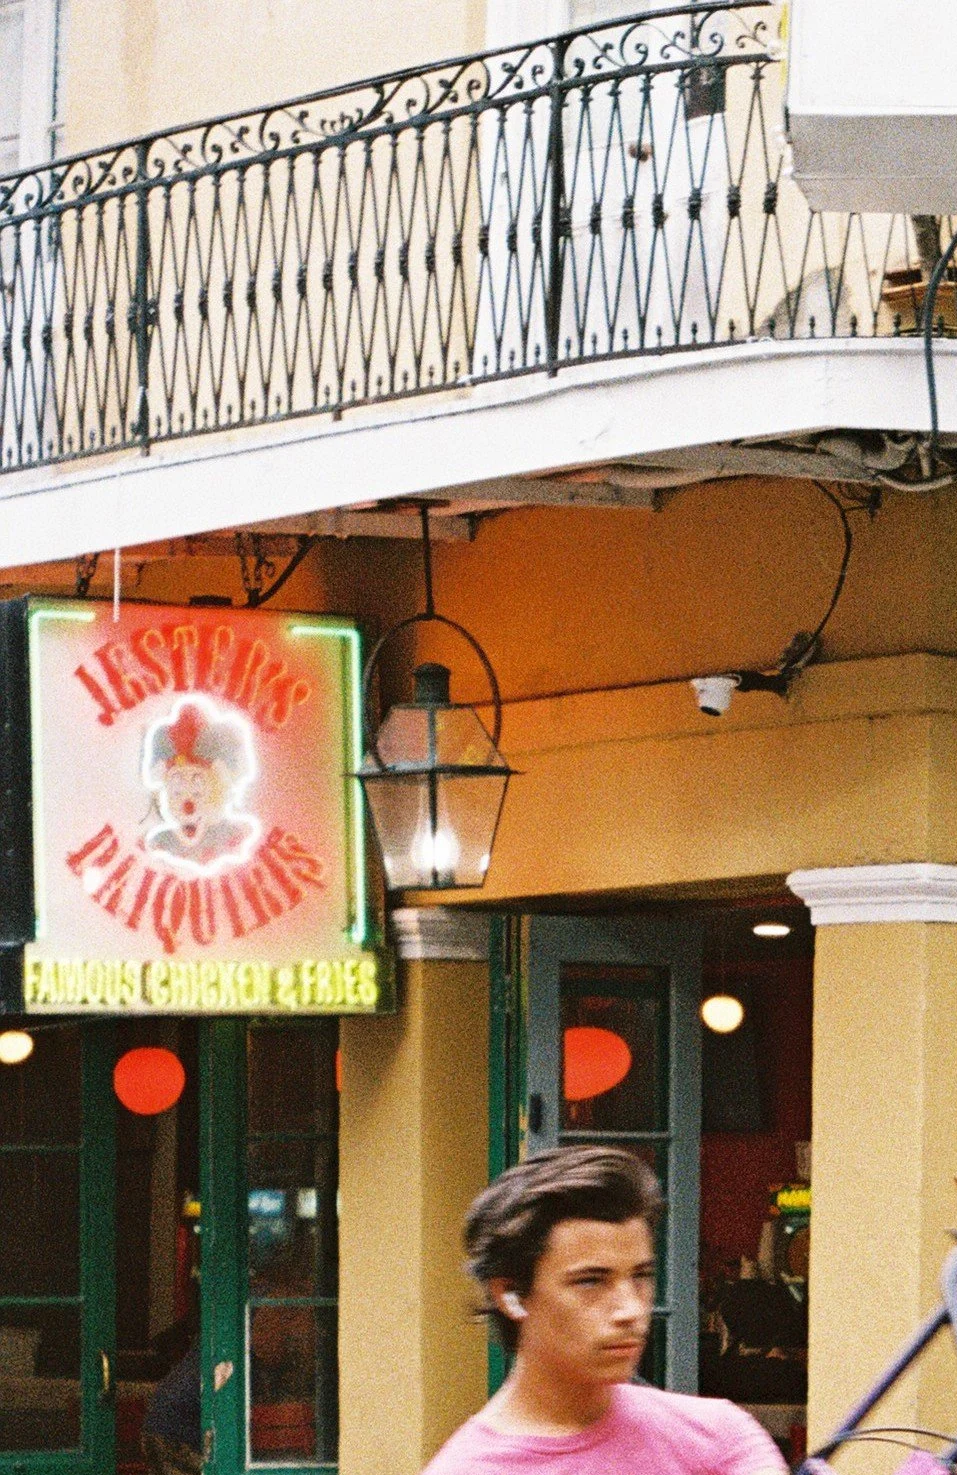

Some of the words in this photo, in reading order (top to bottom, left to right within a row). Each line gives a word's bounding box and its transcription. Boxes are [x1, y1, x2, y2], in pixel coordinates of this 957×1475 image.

[74, 622, 311, 733] JESTERS
[66, 823, 326, 954] DAIQUIRIS
[24, 960, 142, 1004] FAMOUS
[149, 960, 272, 1007] CHICKEN
[300, 960, 378, 1006] FRIES
